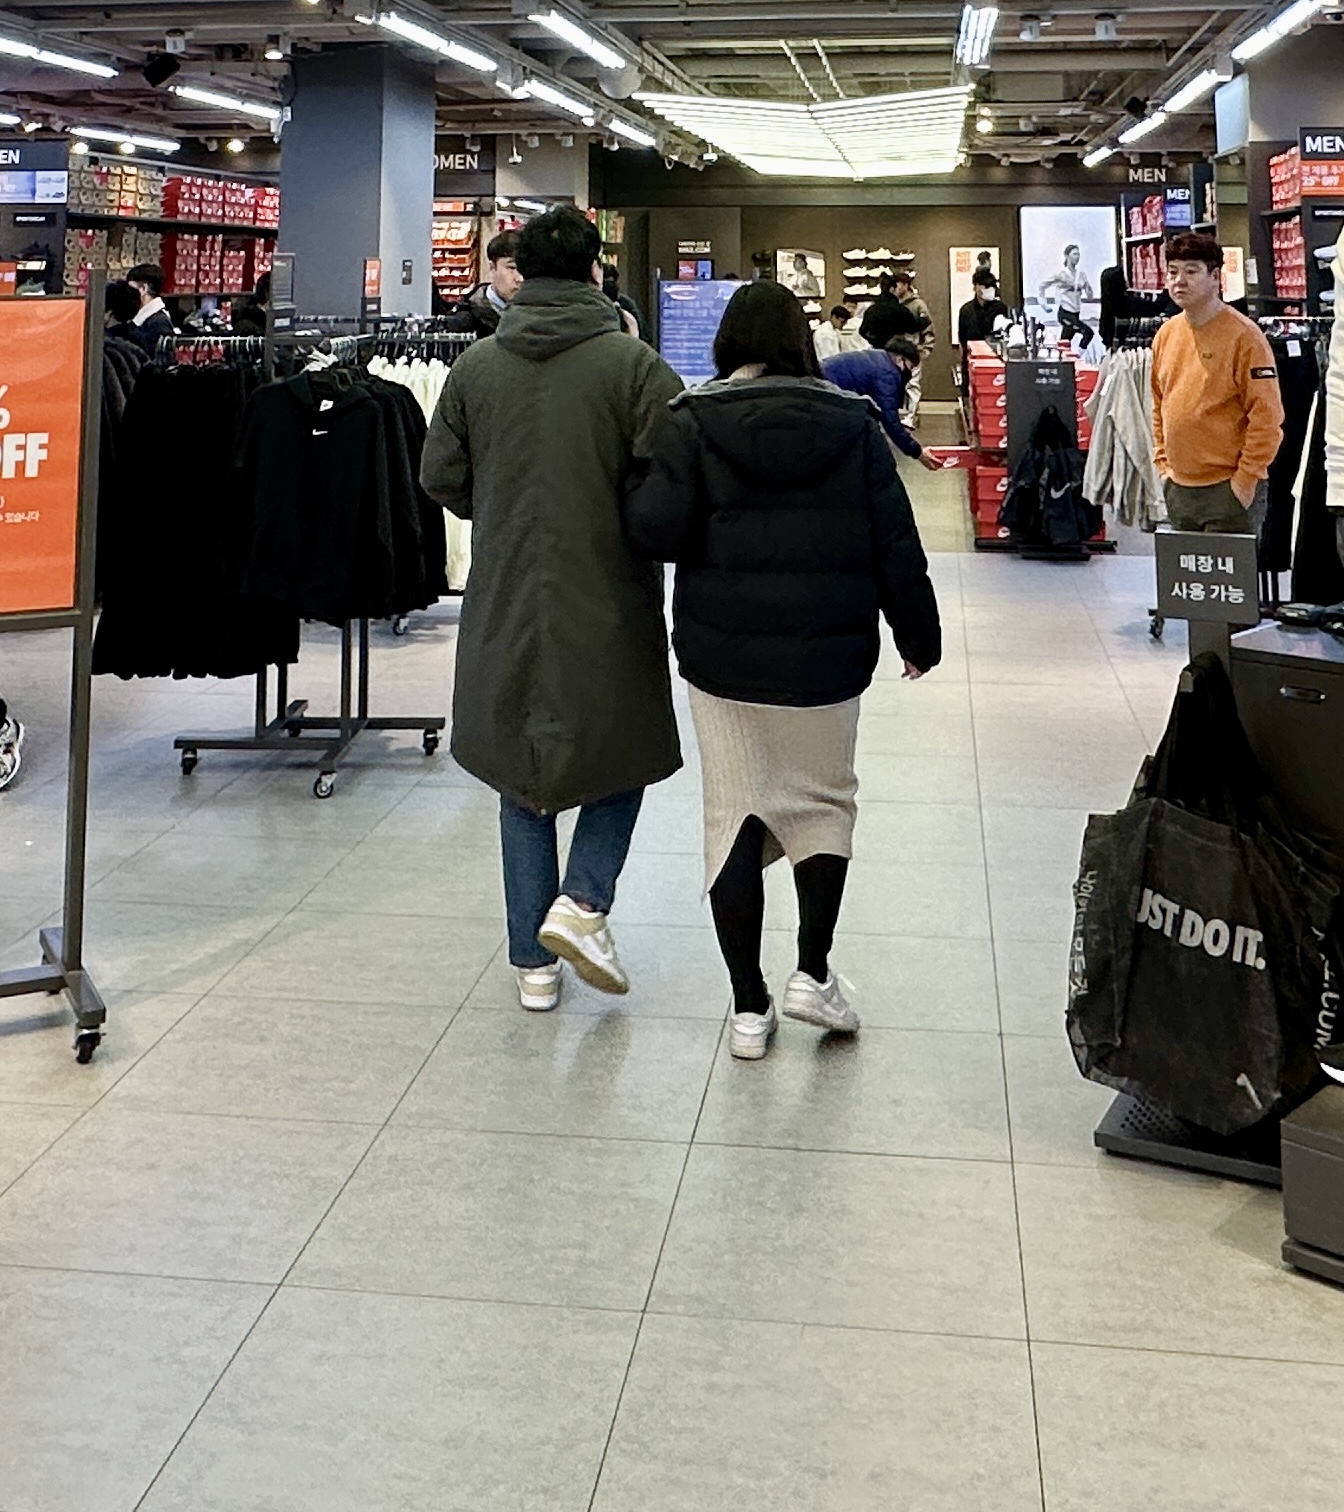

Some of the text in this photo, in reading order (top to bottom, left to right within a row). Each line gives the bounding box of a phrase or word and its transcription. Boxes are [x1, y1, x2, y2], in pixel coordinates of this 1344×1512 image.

[1129, 168, 1166, 182] MEN
[1180, 554, 1234, 574] 매장 내
[1171, 582, 1245, 604] 사용 가능
[1137, 887, 1266, 971] JST DO IT.
